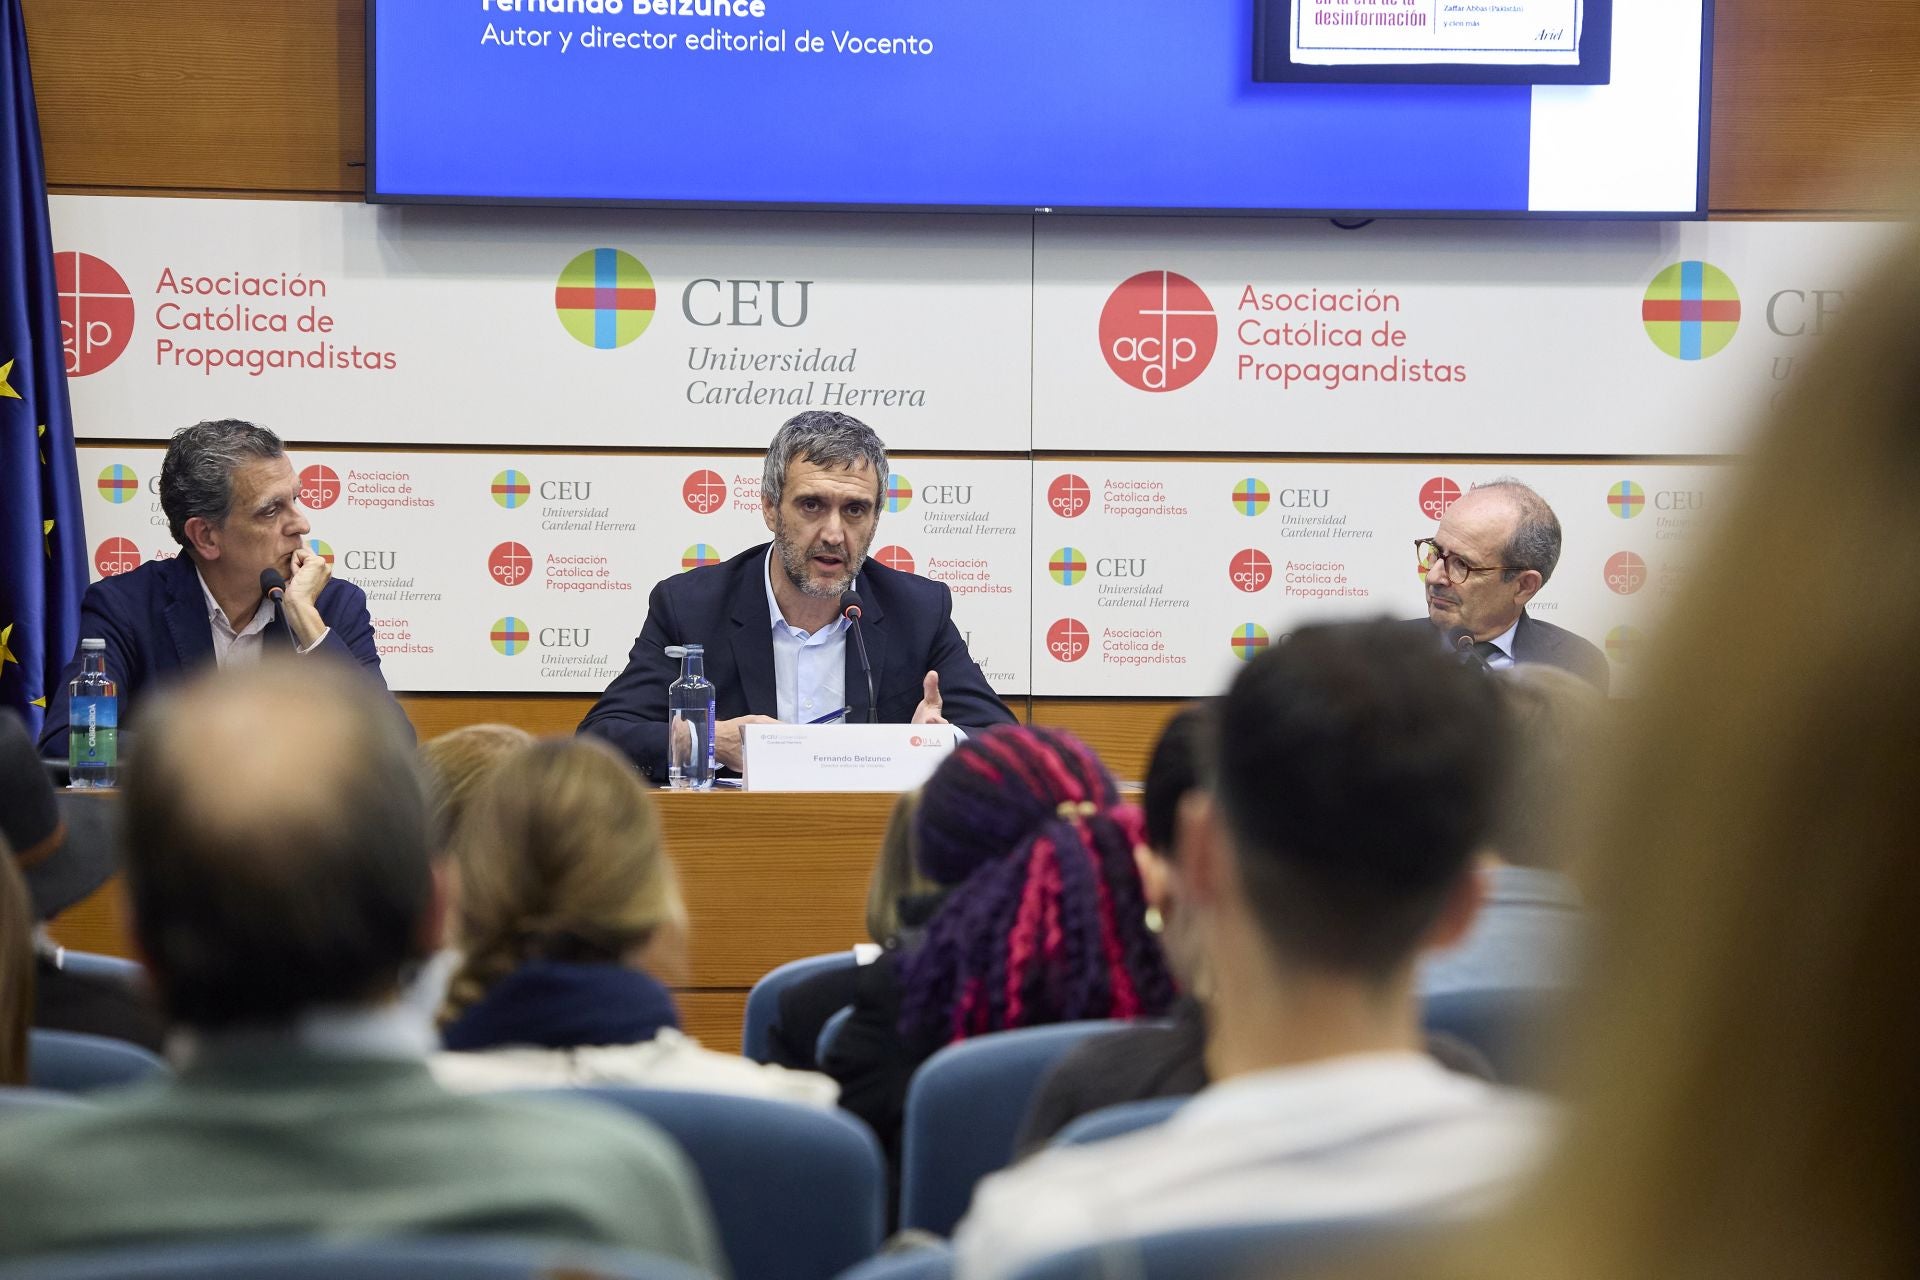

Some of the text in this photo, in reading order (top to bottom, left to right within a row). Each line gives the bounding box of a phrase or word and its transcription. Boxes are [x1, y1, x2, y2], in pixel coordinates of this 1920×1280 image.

[1315, 10, 1427, 26] desinformación
[480, 22, 934, 55] Autor y director editorial de Vocento
[1535, 28, 1564, 41] Ariel
[155, 267, 327, 298] Asociación
[681, 278, 814, 328] CEU
[1238, 284, 1400, 313] Asociación
[155, 302, 335, 333] Católica de
[1237, 318, 1407, 347] Católica de
[156, 339, 398, 377] Propagandistas
[687, 347, 858, 373] Universidad
[1238, 354, 1467, 390] Propagandistas
[686, 380, 926, 407] Cardenal Herrera
[348, 470, 410, 481] Asociación
[347, 483, 412, 494] Católica de
[1104, 479, 1164, 490] Asociación
[540, 481, 592, 501] CEU
[921, 486, 973, 505] CEU
[1104, 491, 1166, 502] Católica de
[348, 496, 435, 509] Propagandistas
[1279, 489, 1330, 508] CEU
[1654, 490, 1704, 510] CEU
[541, 507, 609, 518] Universidad
[924, 511, 990, 522] Universidad
[1104, 504, 1188, 518] Propagandistas
[541, 520, 636, 532] Cardenal Herrera
[1281, 515, 1347, 525] Universidad
[923, 524, 1016, 536] Cardenal Herrera
[1281, 527, 1373, 538] Cardenal Herrera
[344, 550, 397, 570] CEU
[546, 554, 608, 565] Asociación
[928, 557, 988, 568] Asociación
[1286, 560, 1345, 571] Asociación
[546, 567, 610, 578] Católica de
[1096, 558, 1146, 578] CEU
[928, 570, 991, 581] Católica de
[1285, 573, 1348, 584] Católica de
[546, 579, 632, 592] Propagandistas
[1098, 584, 1163, 595] Universidad
[399, 590, 442, 601] Herrera
[1285, 586, 1369, 599] Propagandistas
[1097, 597, 1190, 608] Cardenal Herrera
[1527, 601, 1559, 610] errera
[397, 629, 412, 640] de
[539, 628, 591, 648] CEU
[1103, 627, 1162, 638] Asociación
[1103, 640, 1165, 651] Católica de
[540, 654, 608, 665] Universidad
[1103, 653, 1187, 667] Propagandistas
[540, 667, 591, 678] Cardenal
